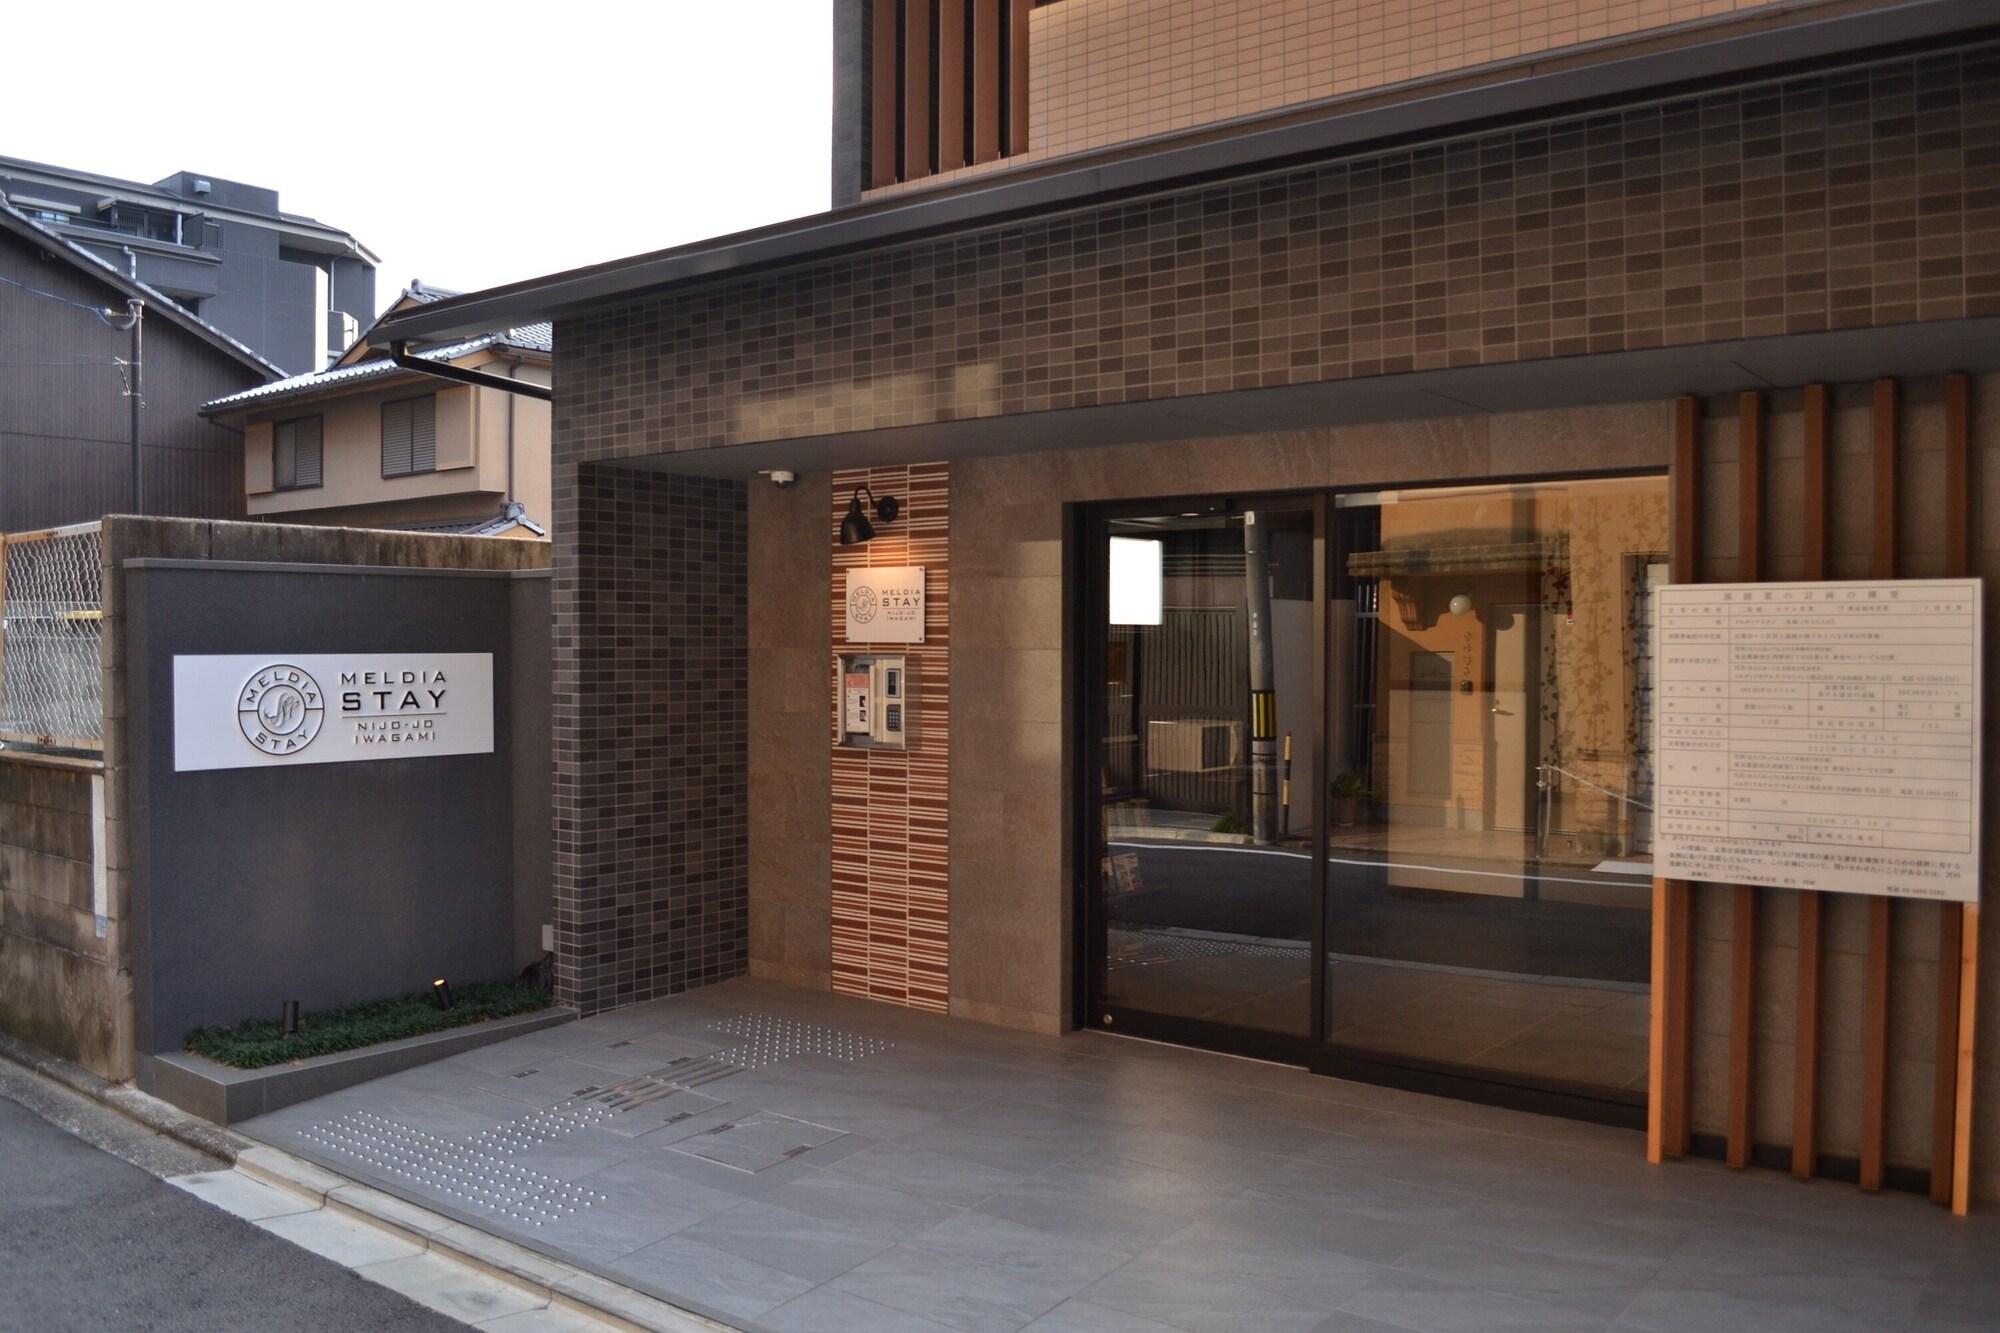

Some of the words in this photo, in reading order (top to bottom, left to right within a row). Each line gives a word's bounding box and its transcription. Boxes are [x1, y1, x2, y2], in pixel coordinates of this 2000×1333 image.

[882, 597, 921, 607] STAY
[246, 670, 317, 704] MELDIA
[341, 671, 447, 686] MELDIA
[342, 689, 447, 712] STAY
[254, 731, 309, 751] STAY
[355, 732, 436, 745] IWAGAMI
